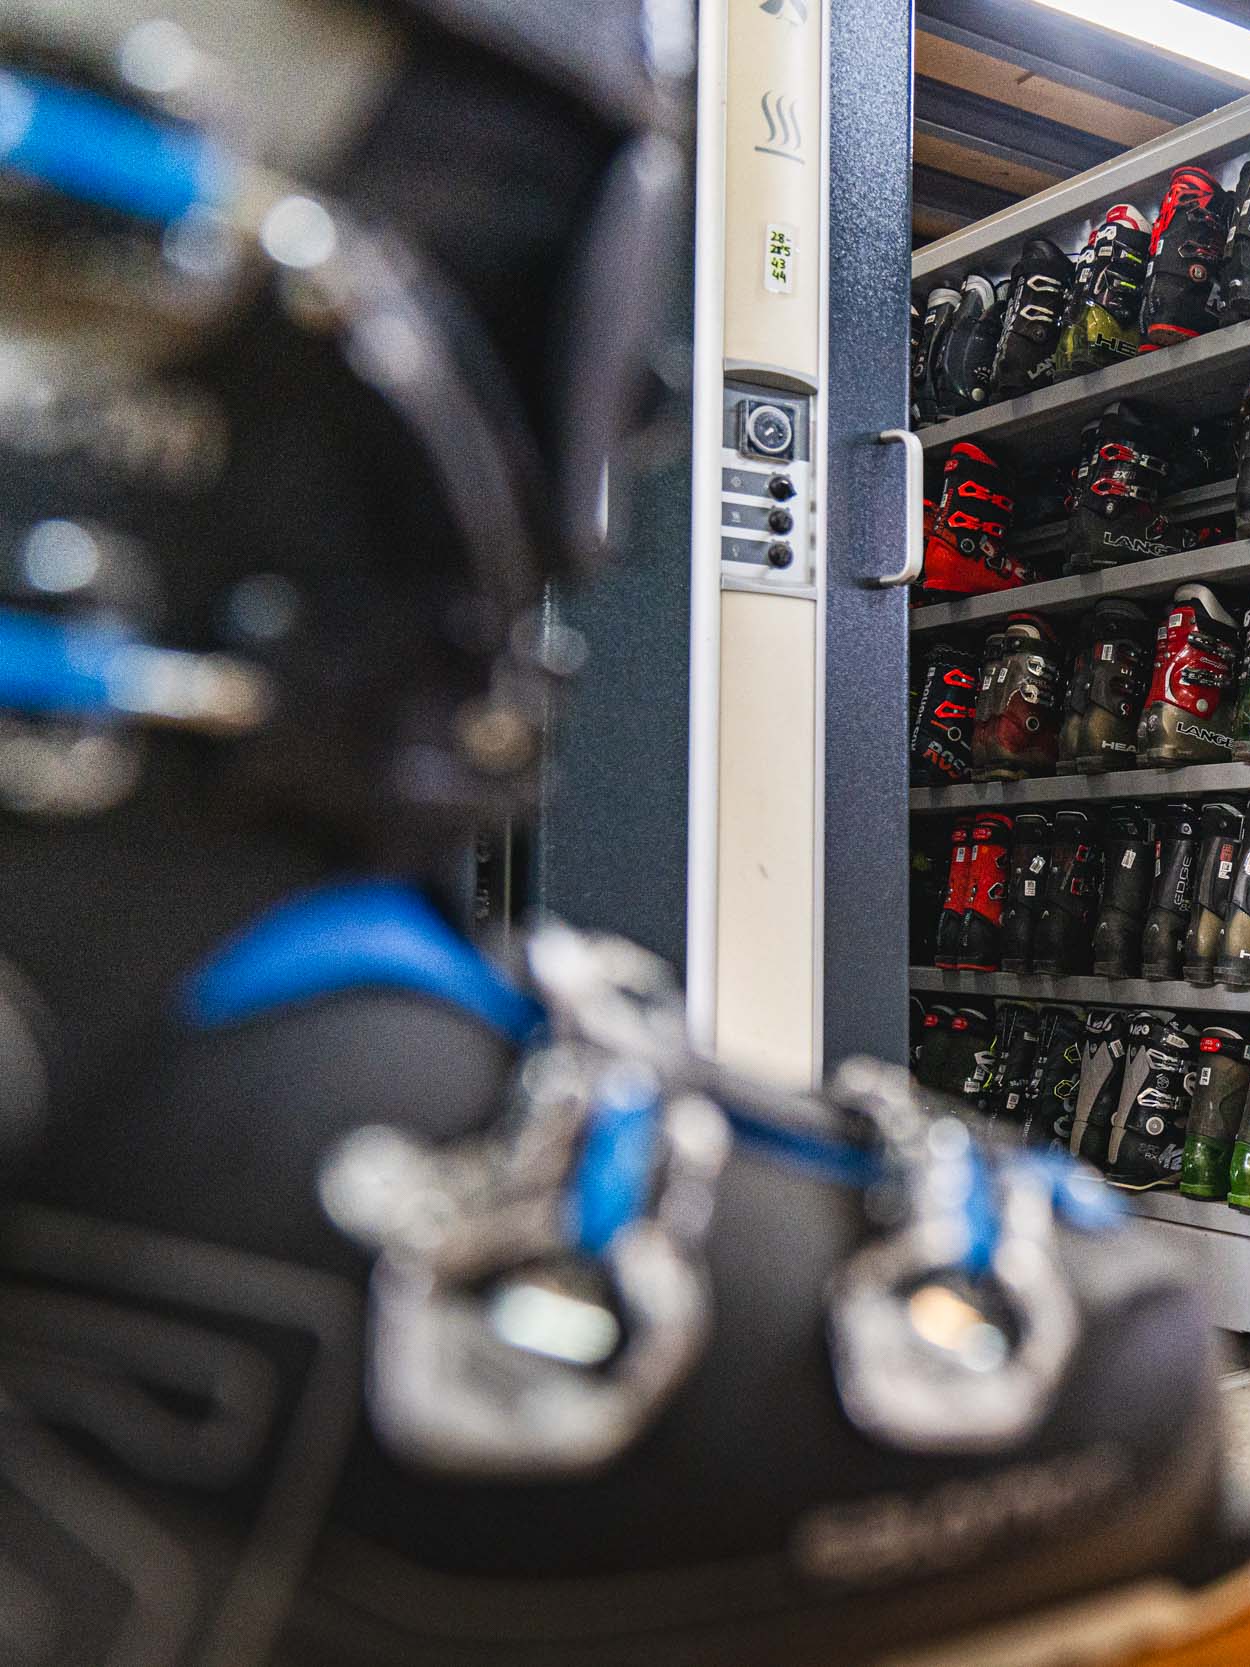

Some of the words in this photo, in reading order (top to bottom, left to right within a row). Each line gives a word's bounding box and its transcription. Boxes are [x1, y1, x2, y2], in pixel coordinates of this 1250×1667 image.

[771, 257, 786, 269] 43
[1103, 531, 1180, 557] LANG
[1173, 855, 1193, 906] EDGE
